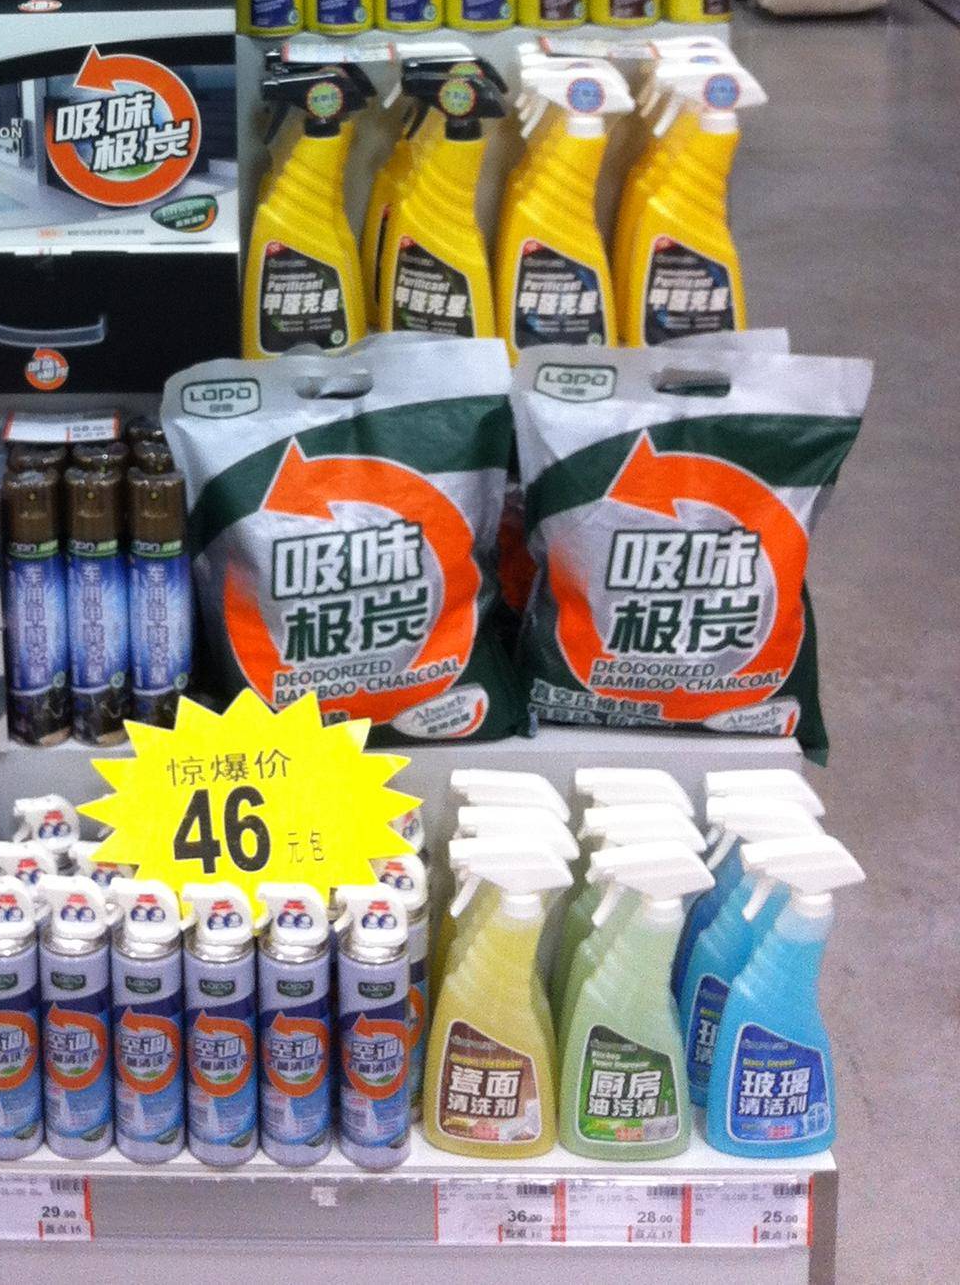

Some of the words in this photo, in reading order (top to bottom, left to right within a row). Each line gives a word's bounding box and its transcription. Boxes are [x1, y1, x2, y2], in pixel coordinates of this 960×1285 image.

[55, 92, 153, 142] 吸味
[92, 120, 190, 172] 极炭
[545, 370, 608, 387] LOPO
[189, 386, 253, 404] LOPO
[274, 521, 422, 599] 吸味
[608, 529, 760, 589] 吸味
[284, 586, 428, 661] 极炭
[608, 595, 760, 654] 极炭
[275, 659, 392, 687] DEODORIZED
[366, 660, 462, 693] CHARCOAL
[590, 674, 677, 690] BAMBOO
[686, 672, 782, 690] CHARCOAL
[593, 661, 715, 677] DEODORIZED
[167, 749, 292, 787] 惊爆价
[173, 786, 271, 874] 46
[590, 1069, 663, 1099] 厨房
[740, 1067, 811, 1097] 玻璃
[447, 1092, 518, 1117] 清洗剂
[587, 1096, 657, 1117] 油污清
